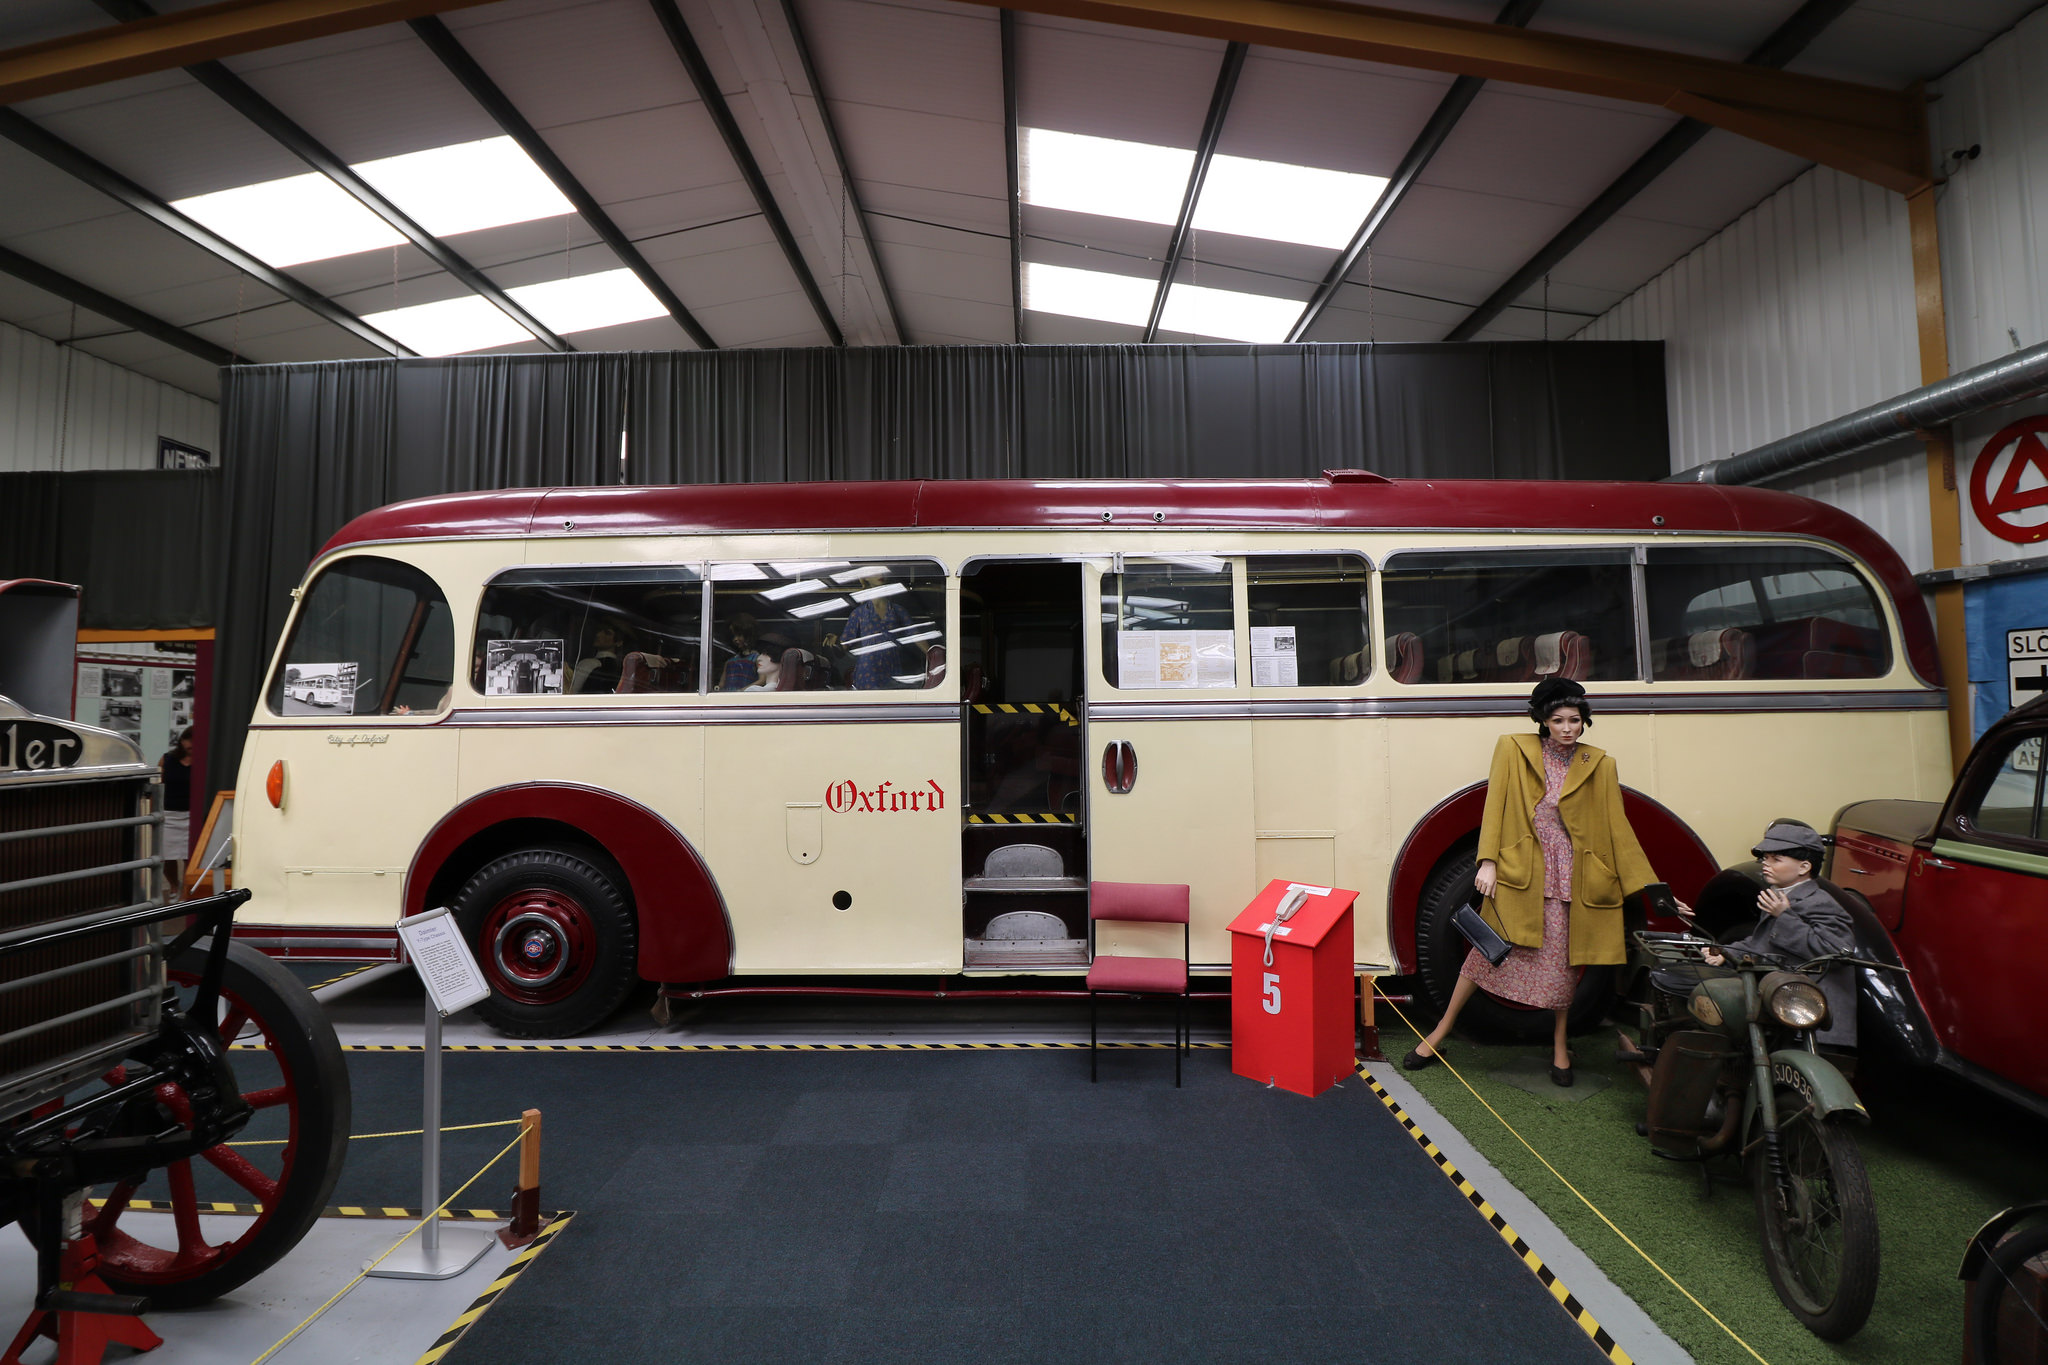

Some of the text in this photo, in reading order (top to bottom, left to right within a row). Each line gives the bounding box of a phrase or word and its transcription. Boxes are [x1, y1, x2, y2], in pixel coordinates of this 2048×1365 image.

[1, 723, 76, 769] ler
[825, 779, 944, 813] Oxford
[1262, 972, 1281, 1015] 5
